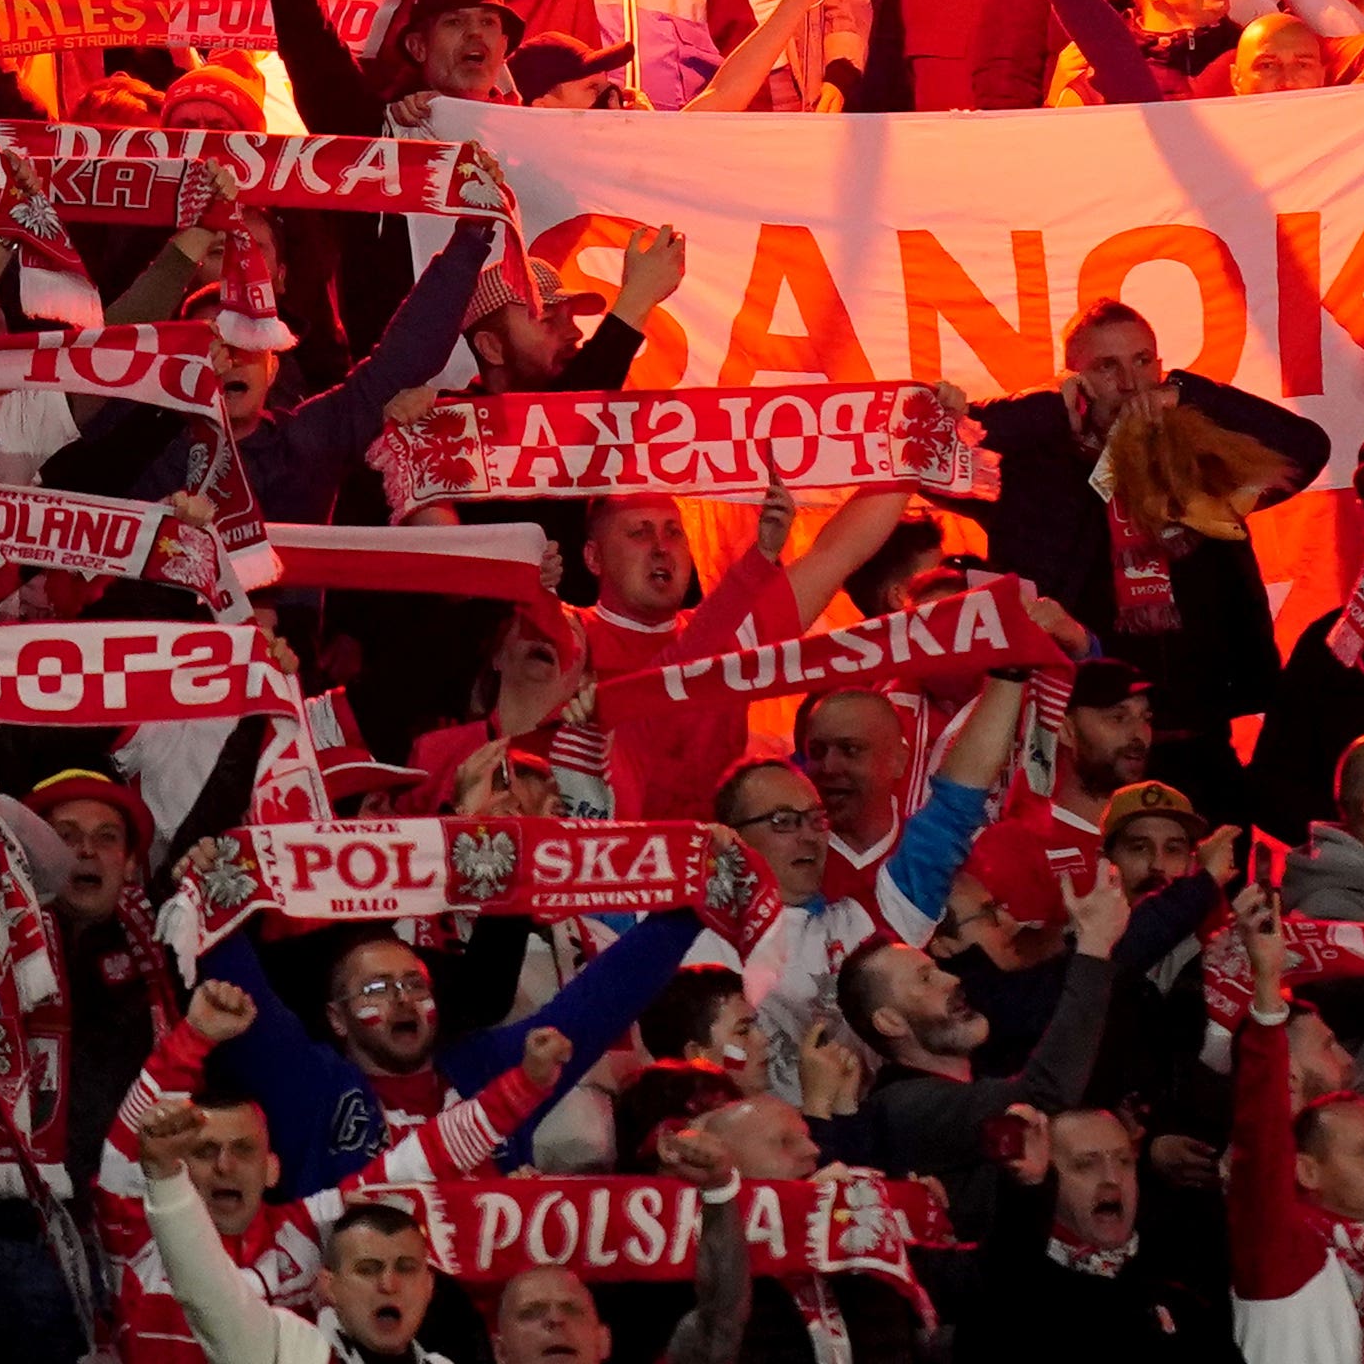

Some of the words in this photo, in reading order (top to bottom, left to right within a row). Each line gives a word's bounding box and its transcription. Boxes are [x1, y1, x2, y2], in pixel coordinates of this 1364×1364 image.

[189, 36, 278, 51] SEPTEMBE
[661, 589, 1010, 702] POLSKA
[287, 840, 437, 891] POL
[532, 838, 678, 885] SKA
[532, 890, 674, 911] CZERWONYM
